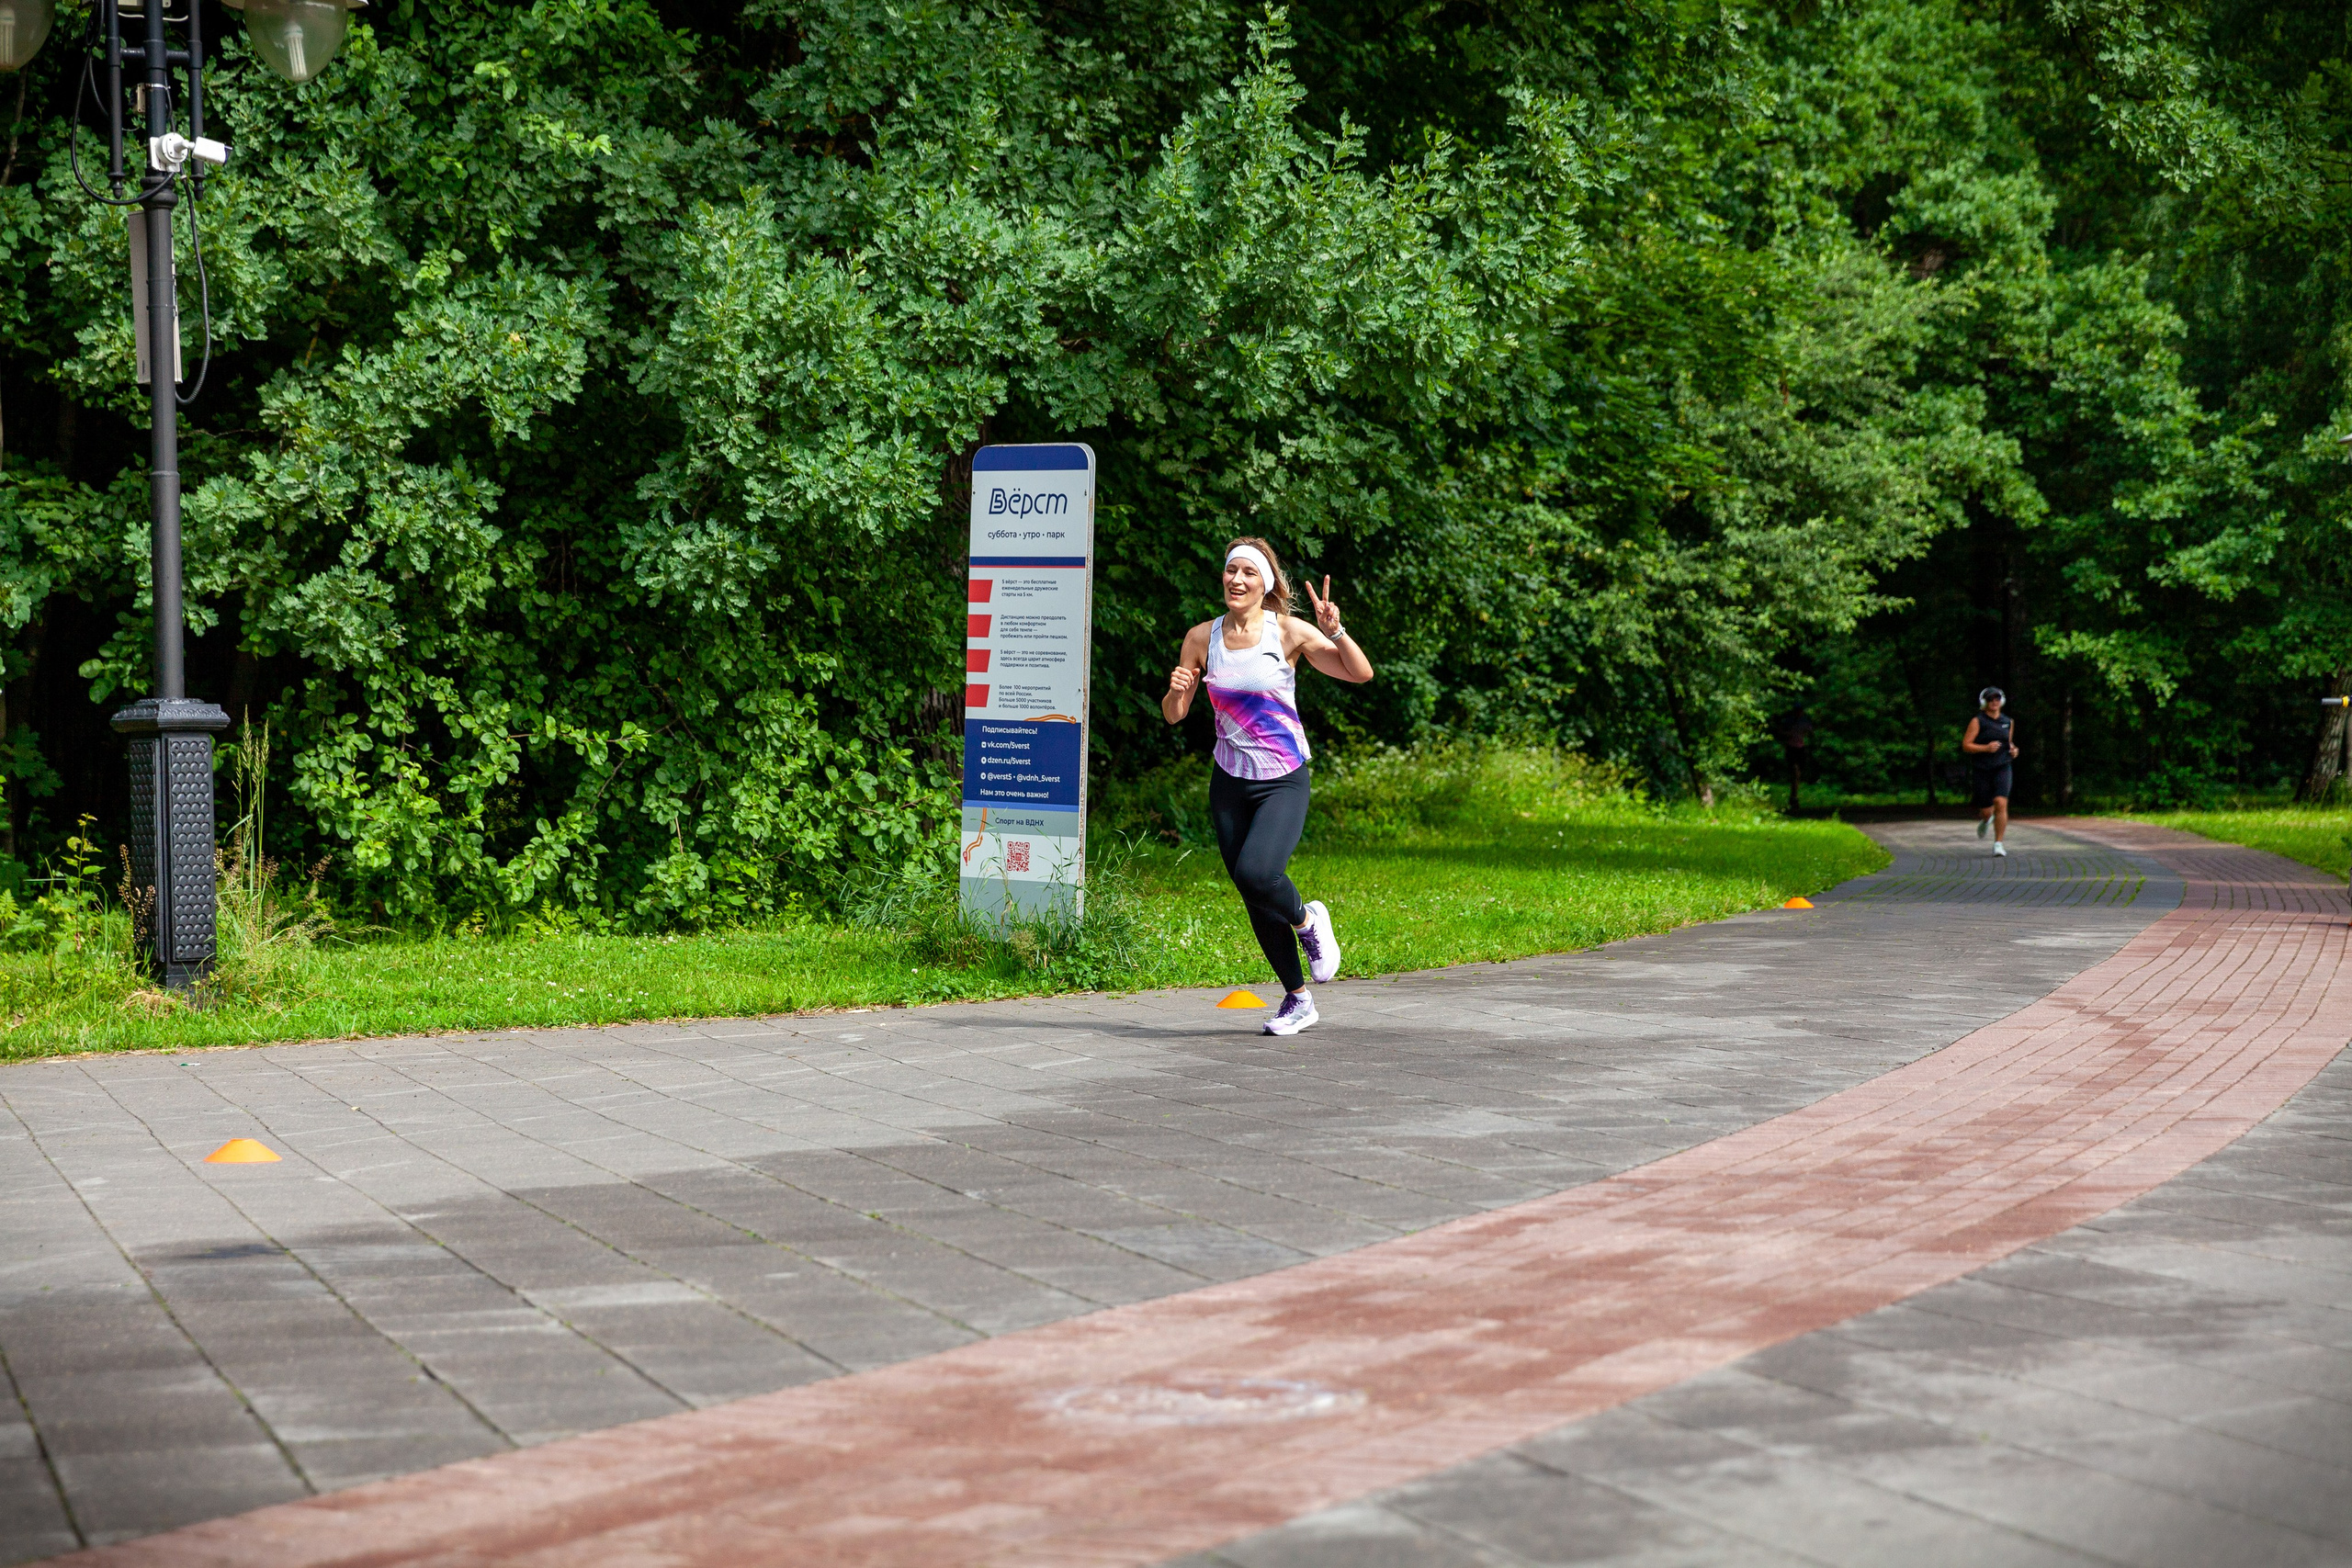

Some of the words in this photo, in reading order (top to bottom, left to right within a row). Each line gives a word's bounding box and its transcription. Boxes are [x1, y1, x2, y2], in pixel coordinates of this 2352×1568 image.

[988, 530, 1017, 539] суббота
[1023, 531, 1041, 539] утро
[1046, 531, 1065, 539] парк
[982, 726, 1037, 735] Подписывайтесь!
[988, 741, 1030, 750] vk.com/5verst
[988, 756, 1031, 765] dzen.ru/5verst
[987, 773, 1012, 781] @verst5
[1017, 773, 1060, 783] @vdnh_5verst
[1025, 818, 1045, 827] ВДНХ
